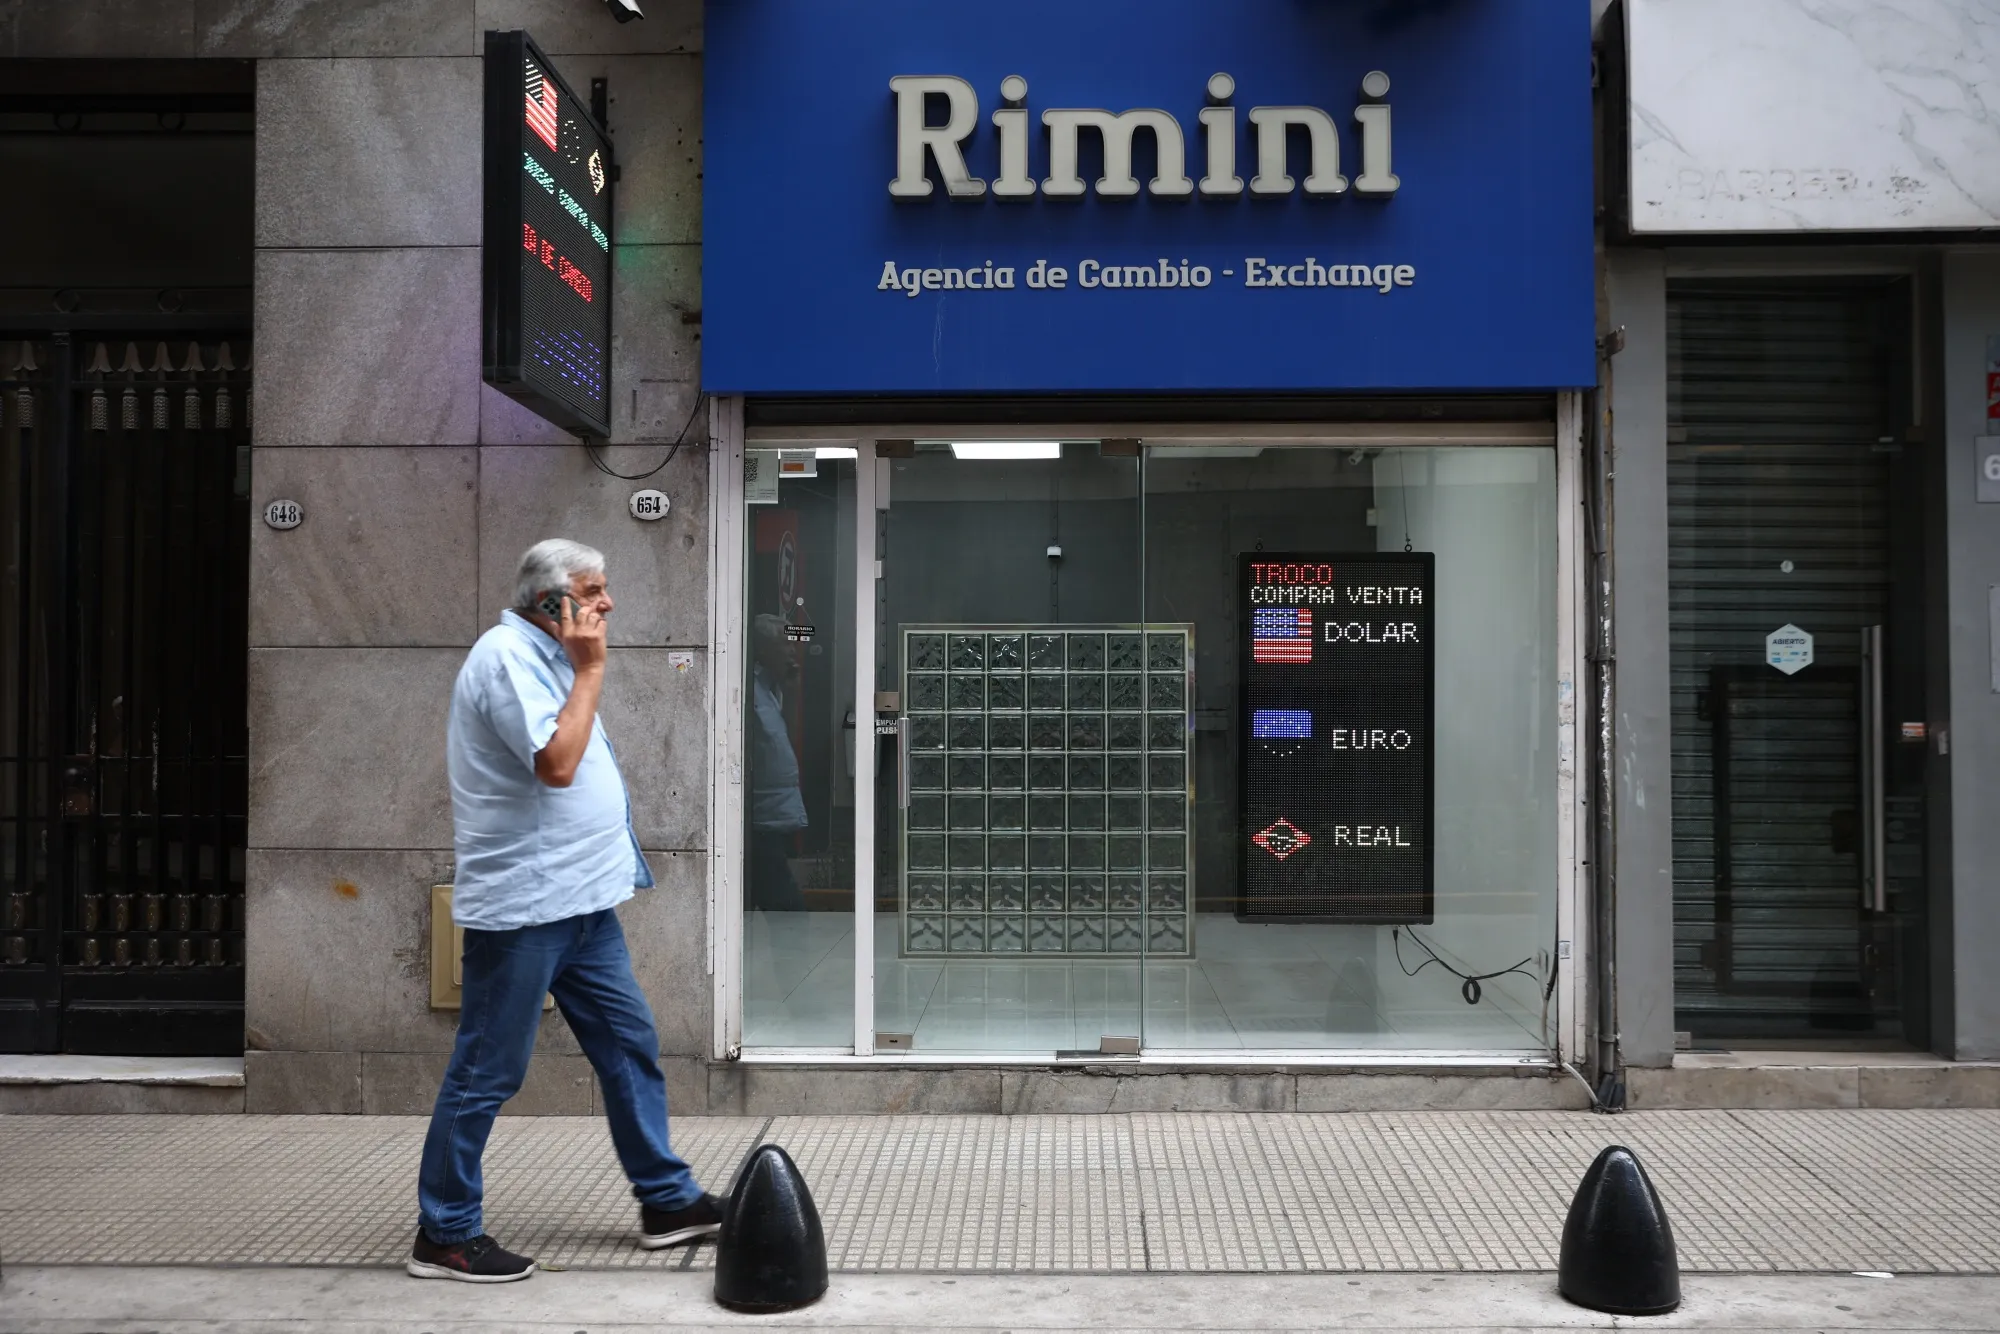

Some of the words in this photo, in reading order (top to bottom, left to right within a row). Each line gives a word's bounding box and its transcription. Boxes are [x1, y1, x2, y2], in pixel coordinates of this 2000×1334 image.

[888, 71, 1400, 199] Rimini
[877, 260, 1015, 297] Agencia
[1026, 259, 1068, 290] de
[1078, 258, 1212, 289] Cambio
[1244, 257, 1416, 295] Exchange
[270, 505, 297, 523] 648
[637, 496, 661, 514] 654
[1250, 563, 1333, 585] TROCO
[1250, 586, 1335, 605] COMPRA
[1347, 586, 1423, 605] VENTA
[1324, 622, 1420, 643] DOLAR
[1332, 729, 1411, 750] EURO
[1334, 825, 1411, 846] REAL
